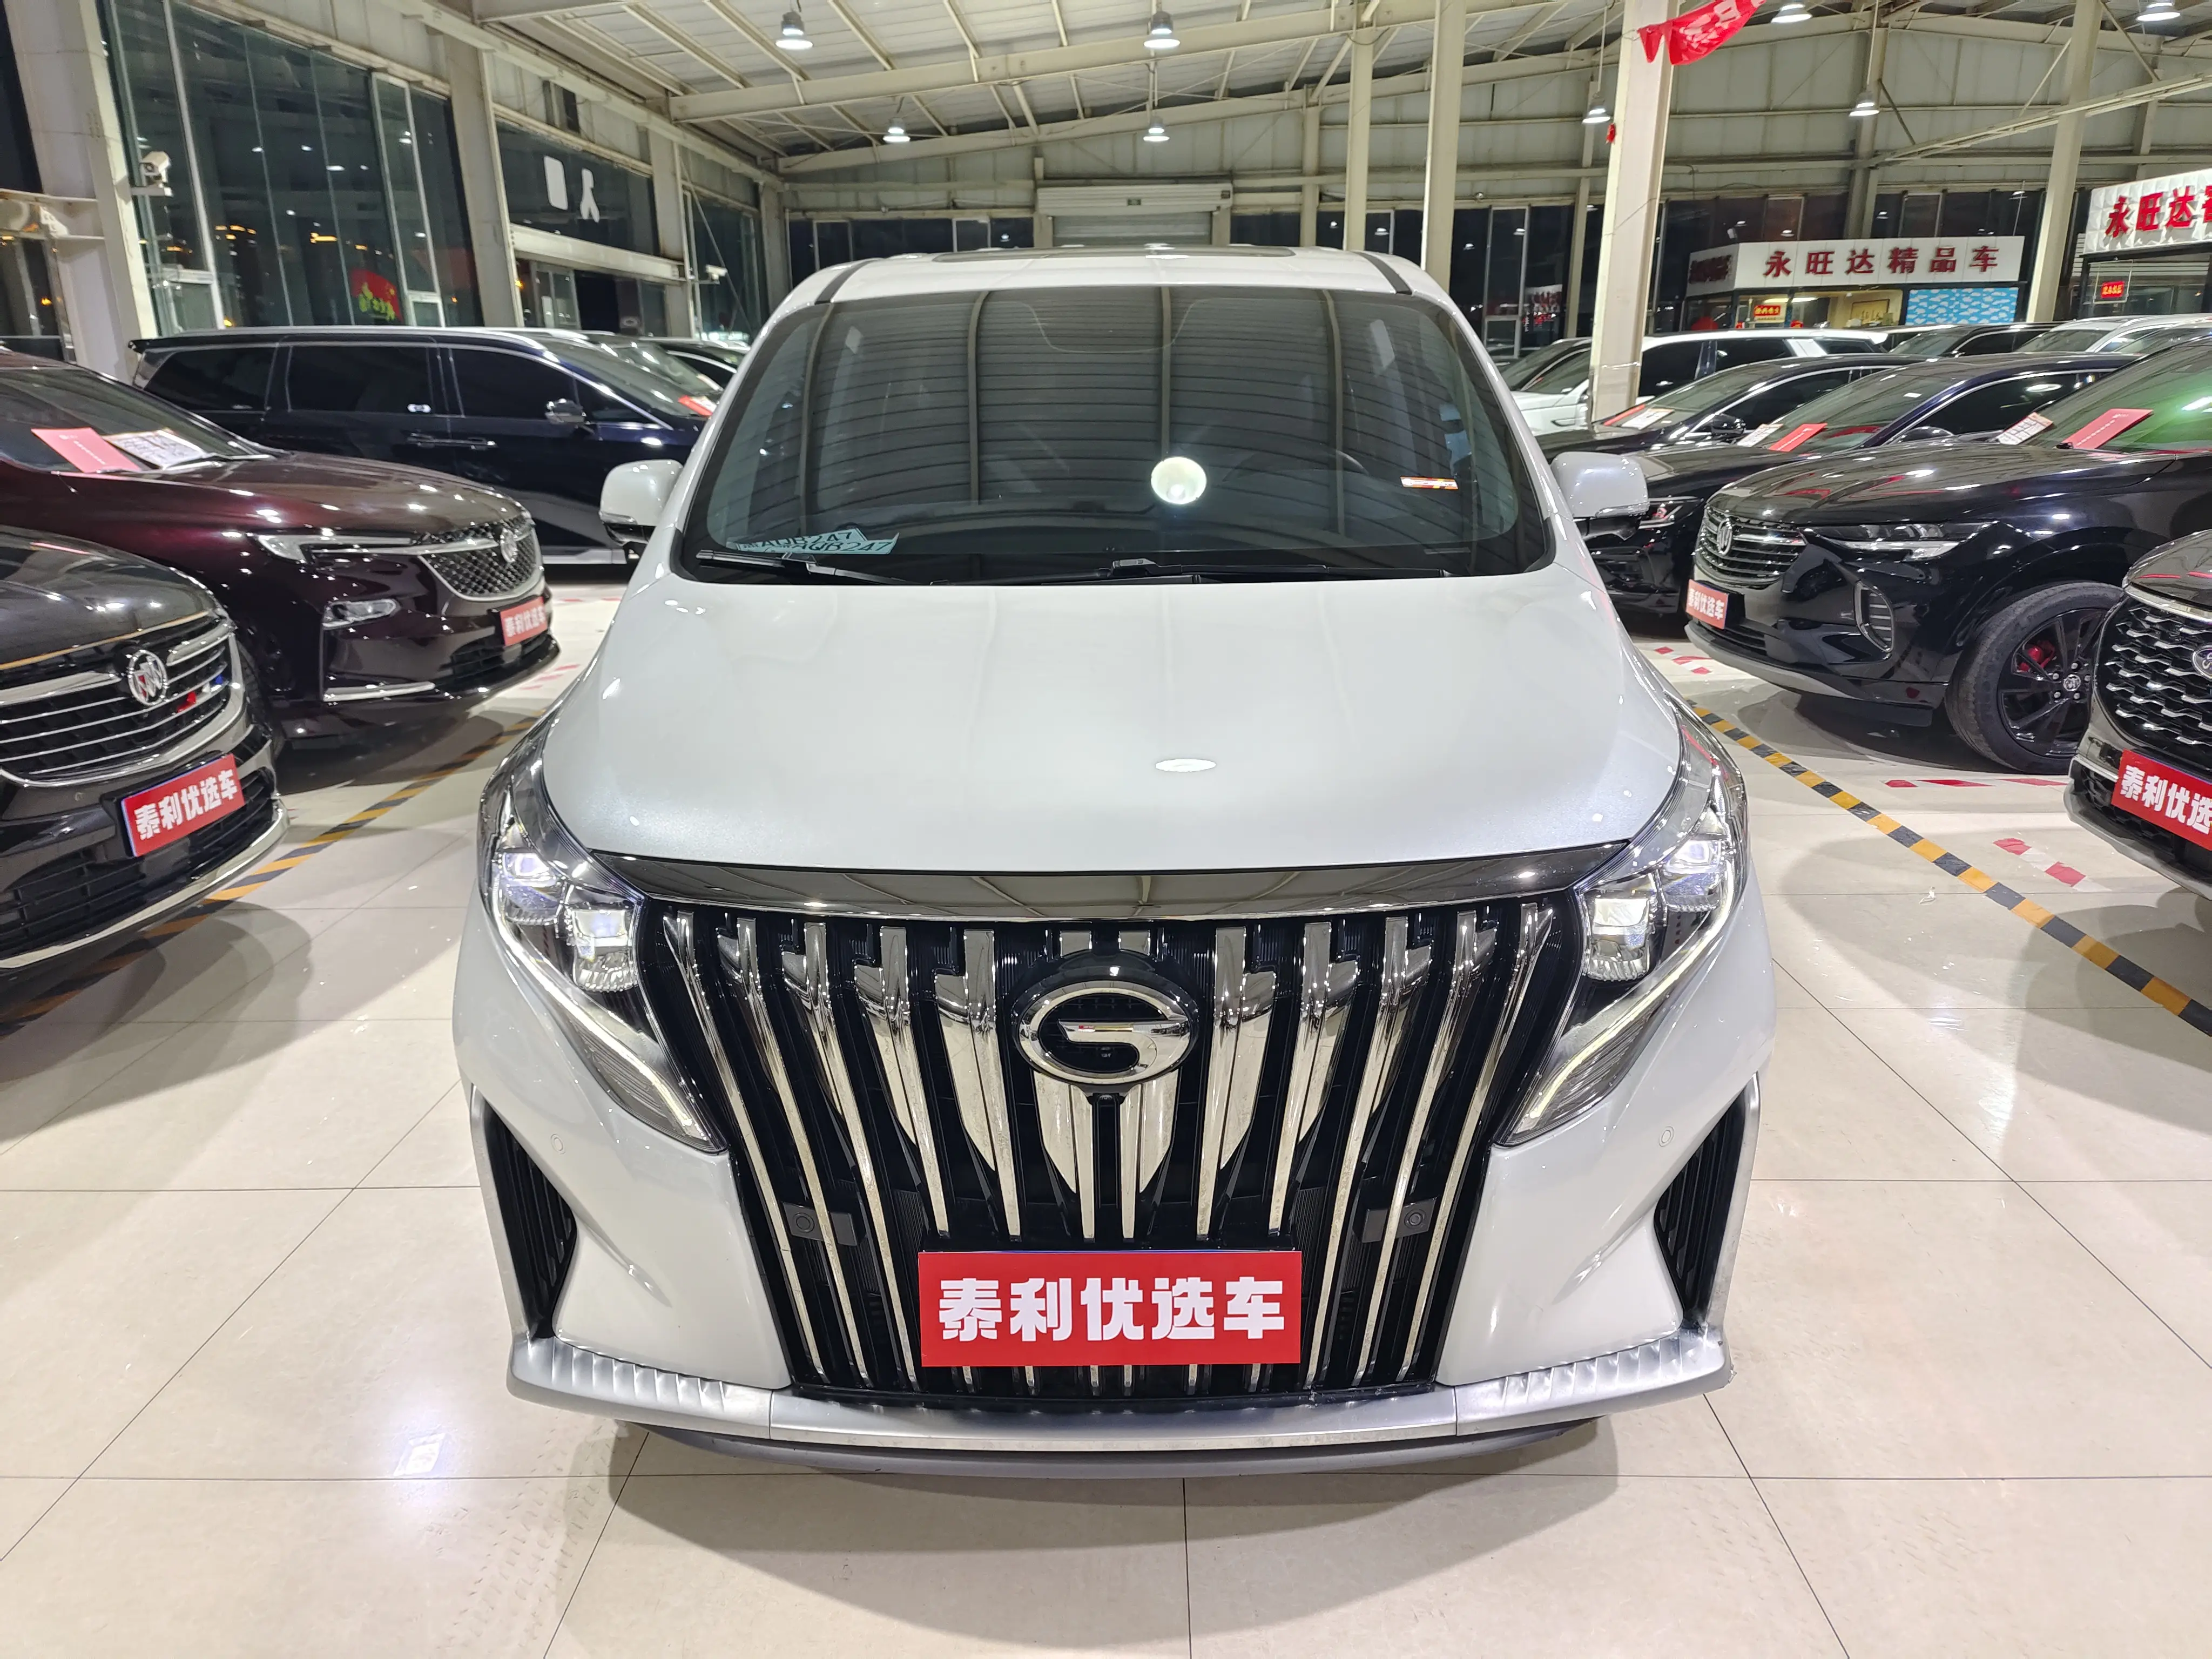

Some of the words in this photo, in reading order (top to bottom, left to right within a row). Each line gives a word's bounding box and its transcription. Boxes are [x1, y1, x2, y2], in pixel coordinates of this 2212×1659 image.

[1763, 245, 1999, 278] 永旺达精品车
[134, 769, 238, 841] 泰利优选车
[939, 1276, 1285, 1342] 泰利优选车
